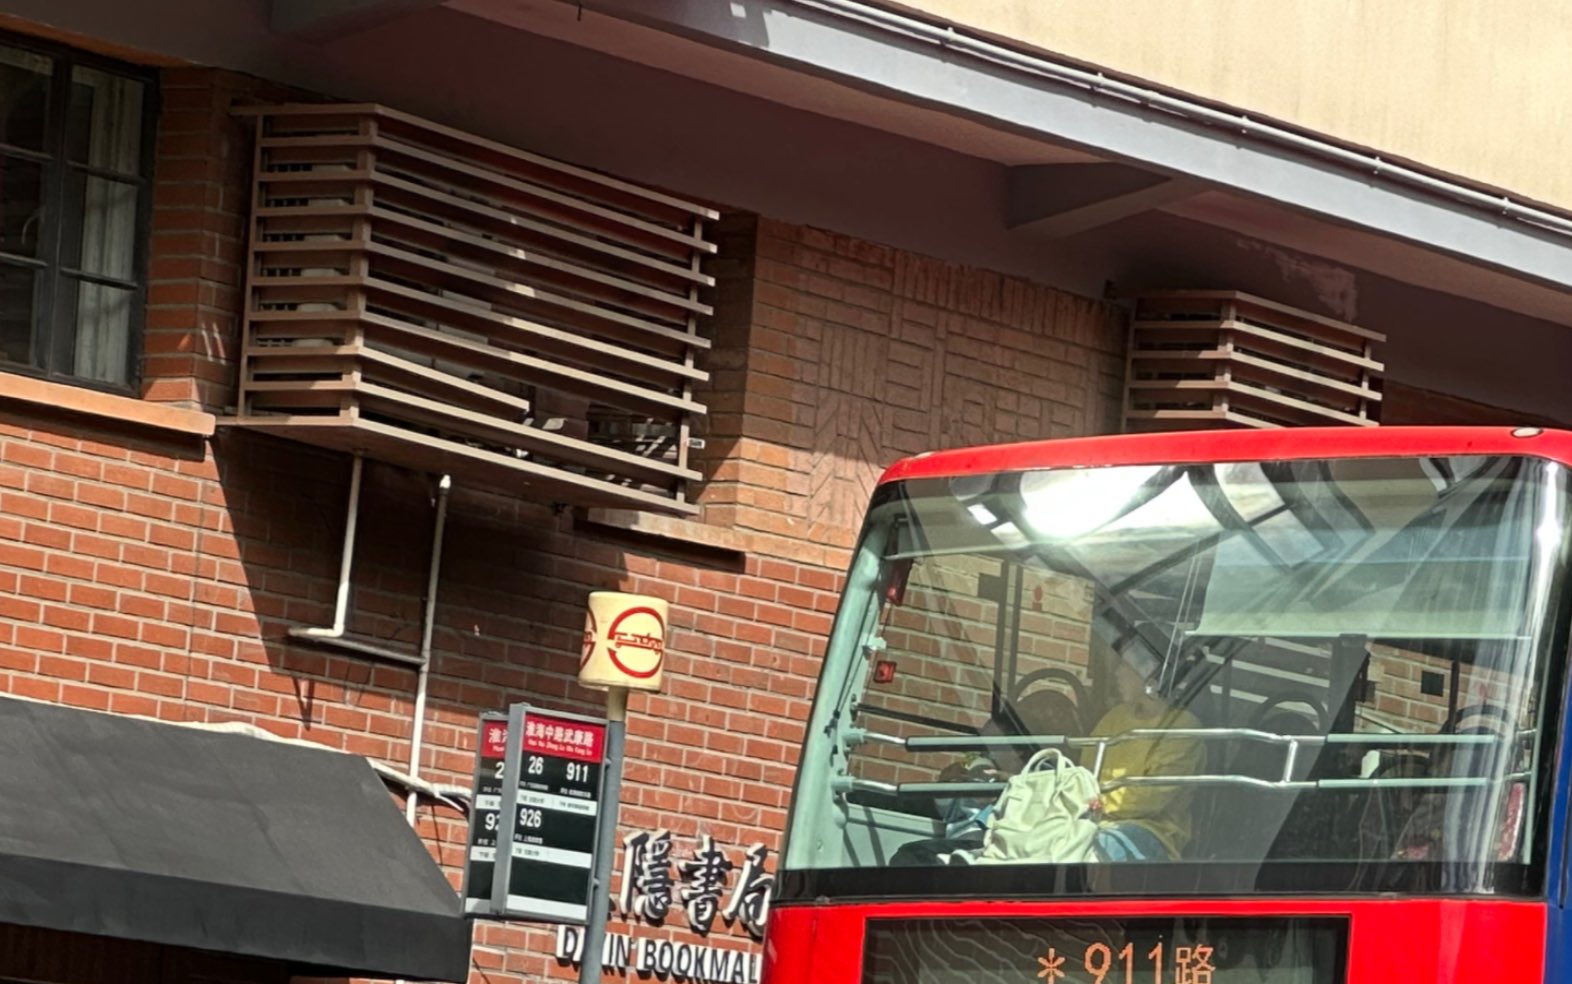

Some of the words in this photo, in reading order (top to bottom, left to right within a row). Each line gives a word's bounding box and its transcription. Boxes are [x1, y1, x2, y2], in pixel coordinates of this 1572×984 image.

[528, 756, 544, 774] 26
[566, 763, 588, 783] 911
[519, 808, 541, 828] 926
